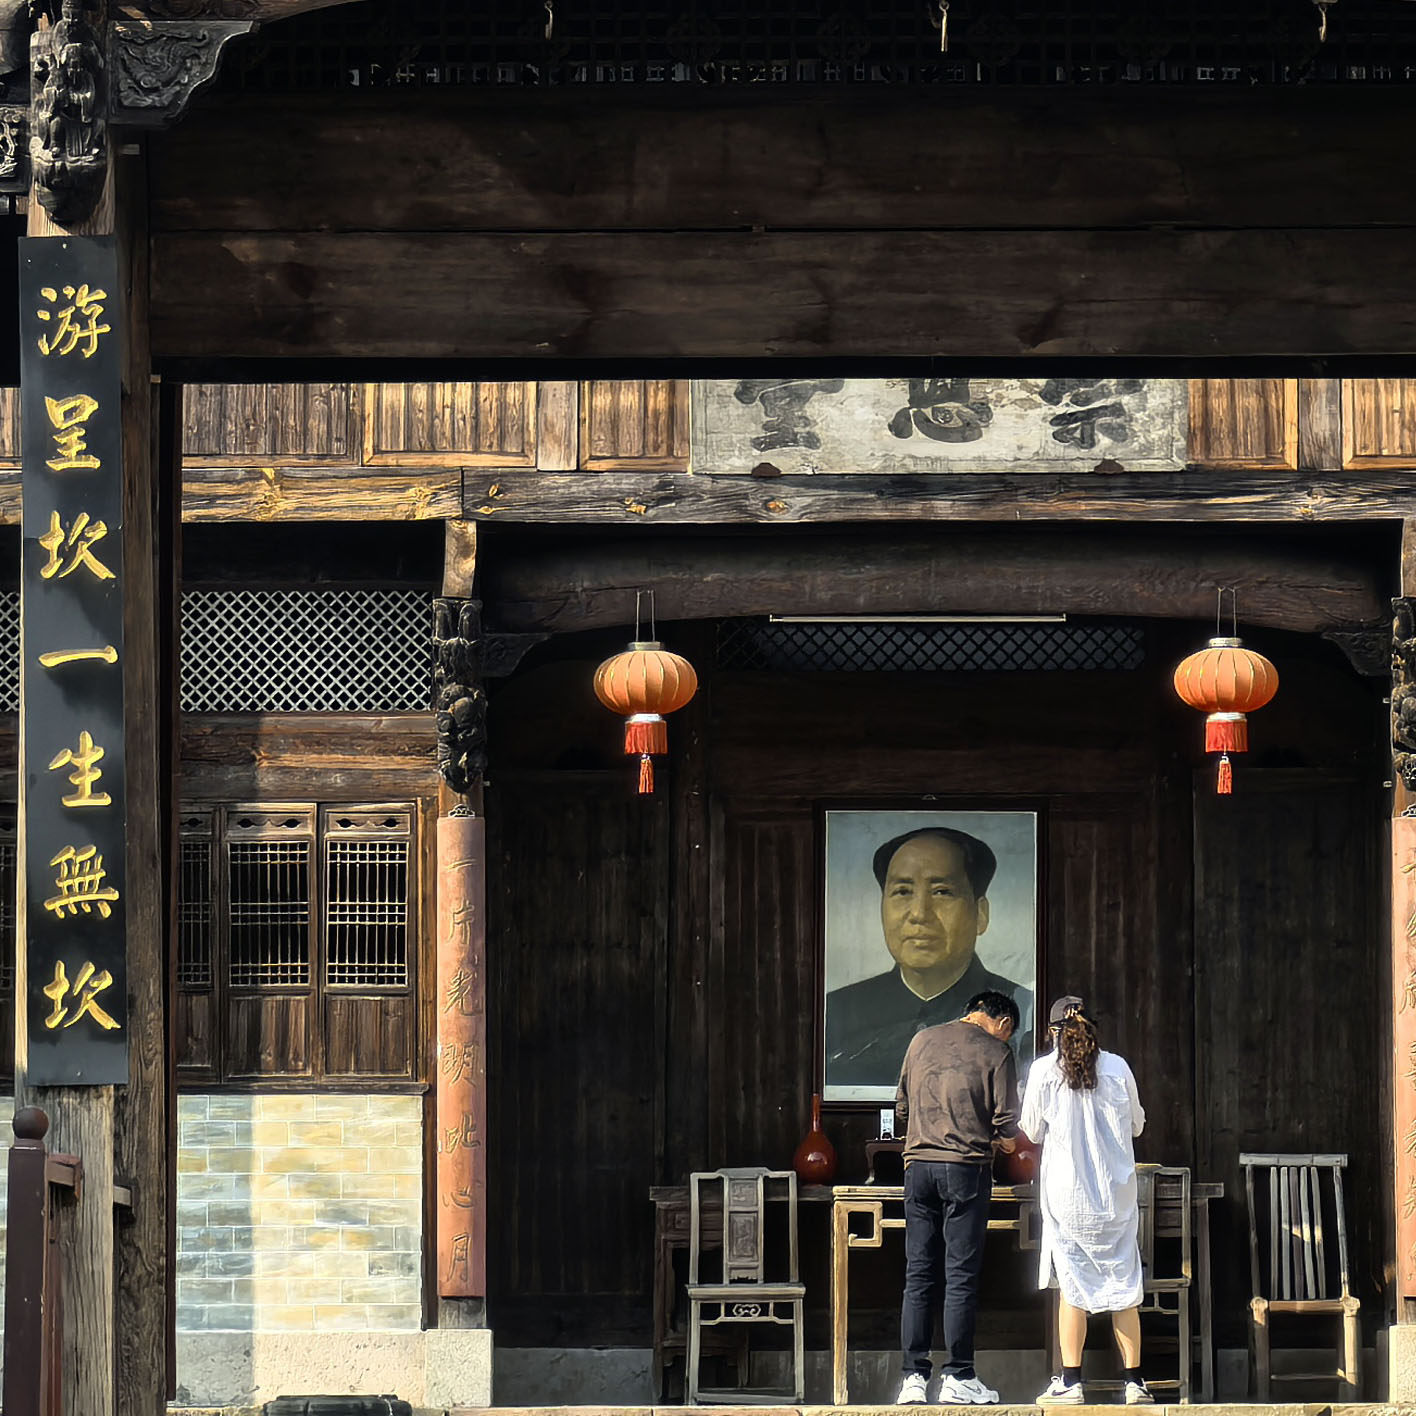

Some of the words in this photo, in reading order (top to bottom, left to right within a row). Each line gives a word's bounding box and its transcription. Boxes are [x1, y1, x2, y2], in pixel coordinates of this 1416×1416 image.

[38, 285, 121, 1030] 游呈坎一生無坎
